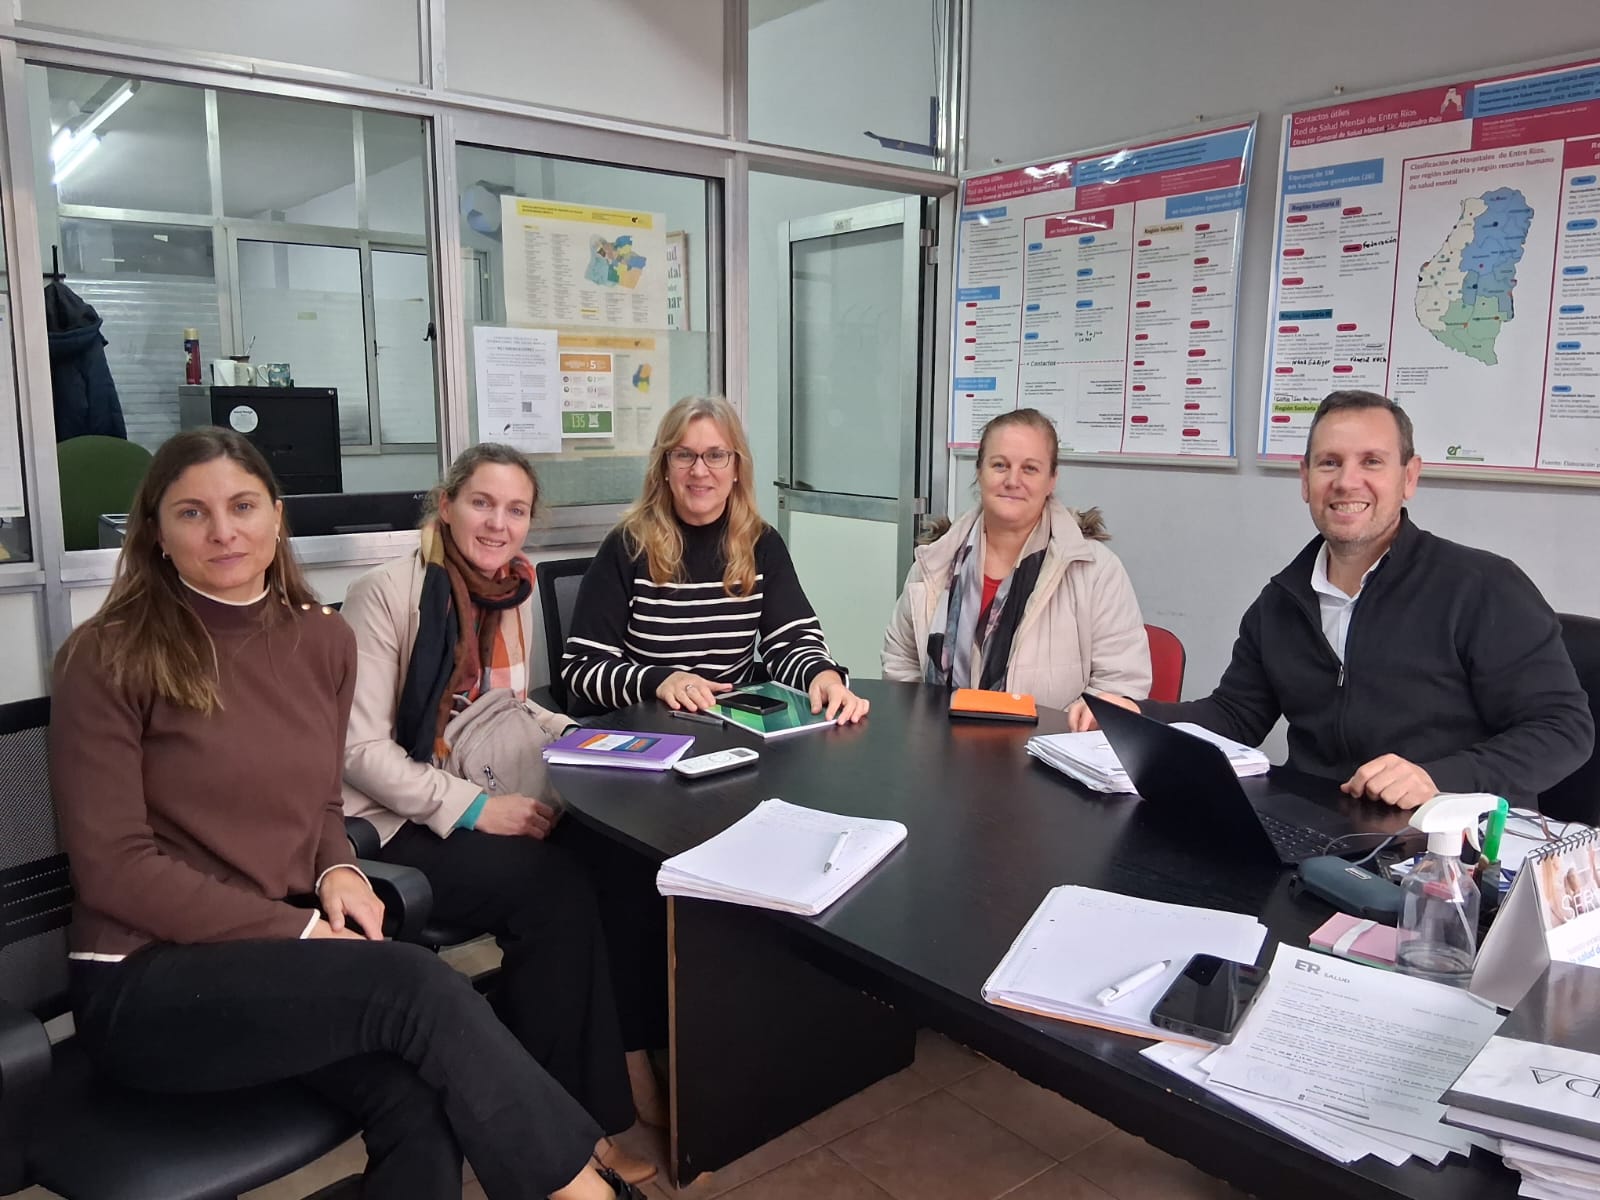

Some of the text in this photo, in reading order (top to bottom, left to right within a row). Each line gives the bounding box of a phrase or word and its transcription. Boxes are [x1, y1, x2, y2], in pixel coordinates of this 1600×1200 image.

[1293, 108, 1417, 136] Red de Salud Mental de Entre Ríos
[1294, 109, 1350, 125] Contactos útiles
[1292, 135, 1315, 146] Director
[1316, 132, 1338, 143] General
[1339, 131, 1346, 139] de
[1346, 127, 1363, 137] Salud
[1450, 157, 1459, 165] de
[1460, 154, 1495, 166] Hospitales
[1498, 151, 1508, 159] de
[1508, 148, 1528, 158] Entre
[1409, 173, 1421, 181] por
[1421, 170, 1442, 180] región
[1442, 166, 1471, 177] sanitaria
[1477, 162, 1498, 173] según
[1498, 160, 1525, 170] recurso
[1409, 178, 1458, 190] de salud mental
[1294, 959, 1351, 984] ER SALUD
